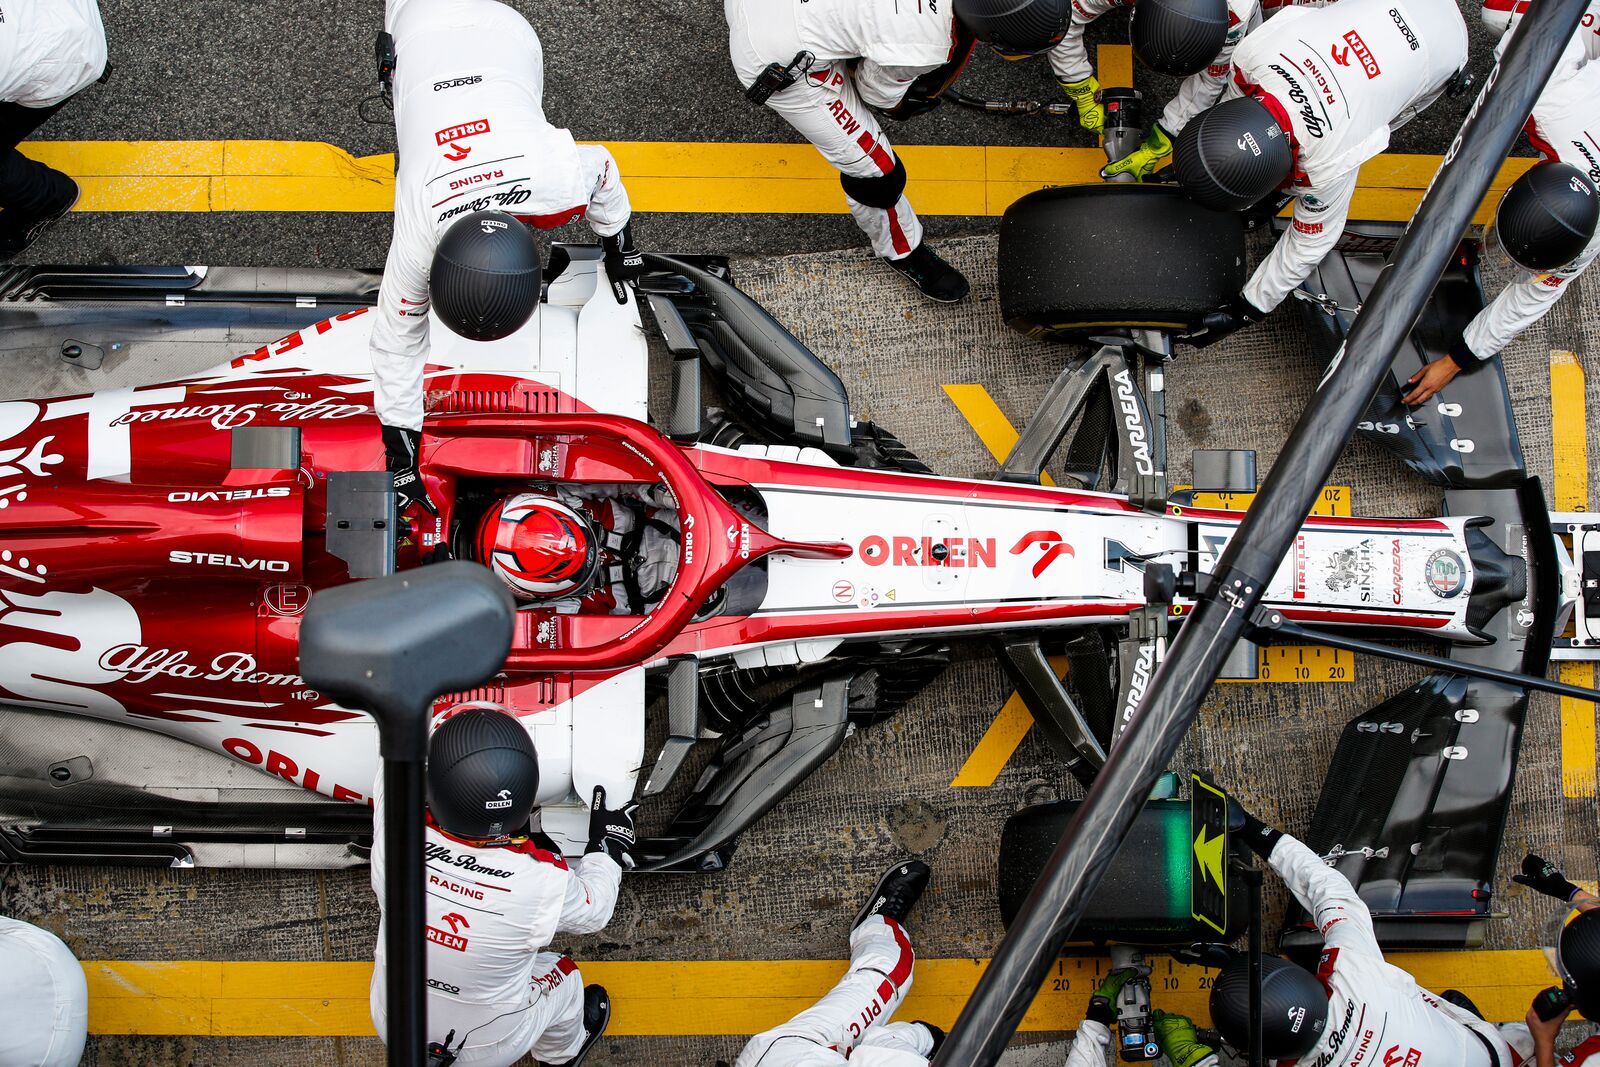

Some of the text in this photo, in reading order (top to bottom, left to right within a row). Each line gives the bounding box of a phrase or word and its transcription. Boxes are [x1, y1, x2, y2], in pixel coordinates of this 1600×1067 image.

[1389, 8, 1420, 51] sparco
[1347, 34, 1378, 76] ORLEN
[433, 75, 483, 92] sparco
[1269, 64, 1306, 105] Romeo
[1302, 58, 1335, 105] RACING
[439, 121, 487, 144] ORLEN
[826, 99, 860, 136] REW
[1299, 98, 1324, 139] Alfa
[1244, 132, 1261, 156] ORLEN
[449, 169, 504, 190] RACING
[437, 184, 532, 224] Alfa Romeo
[109, 396, 370, 431] Alfa Romeo
[1113, 368, 1155, 476] CARRERA
[551, 445, 559, 478] SINGHA
[167, 486, 291, 502] STELVIO
[685, 532, 693, 565] ORLEN
[741, 523, 750, 559] ORLEN
[858, 534, 996, 568] ORLEN
[169, 551, 290, 572] STELVIO
[1360, 539, 1371, 603] SINGHA
[1392, 538, 1401, 605] CARRERA
[549, 615, 557, 649] SINGHA
[99, 643, 304, 686] Alfa Rom
[1296, 667, 1310, 679] 10
[1328, 666, 1345, 679] 20
[1119, 645, 1156, 735] RRERA
[487, 800, 511, 808] ORLEN
[605, 823, 635, 840] sparco
[453, 853, 515, 879] Romeo
[429, 874, 484, 901] RACING
[427, 929, 465, 950] RLEN
[427, 978, 460, 995] arco
[1053, 978, 1070, 991] 20
[1164, 977, 1214, 990] 10 20
[860, 999, 882, 1030] PIT
[1291, 1007, 1305, 1033] ORLEN
[1328, 998, 1355, 1054] Romeo
[1350, 1029, 1374, 1067] ACING
